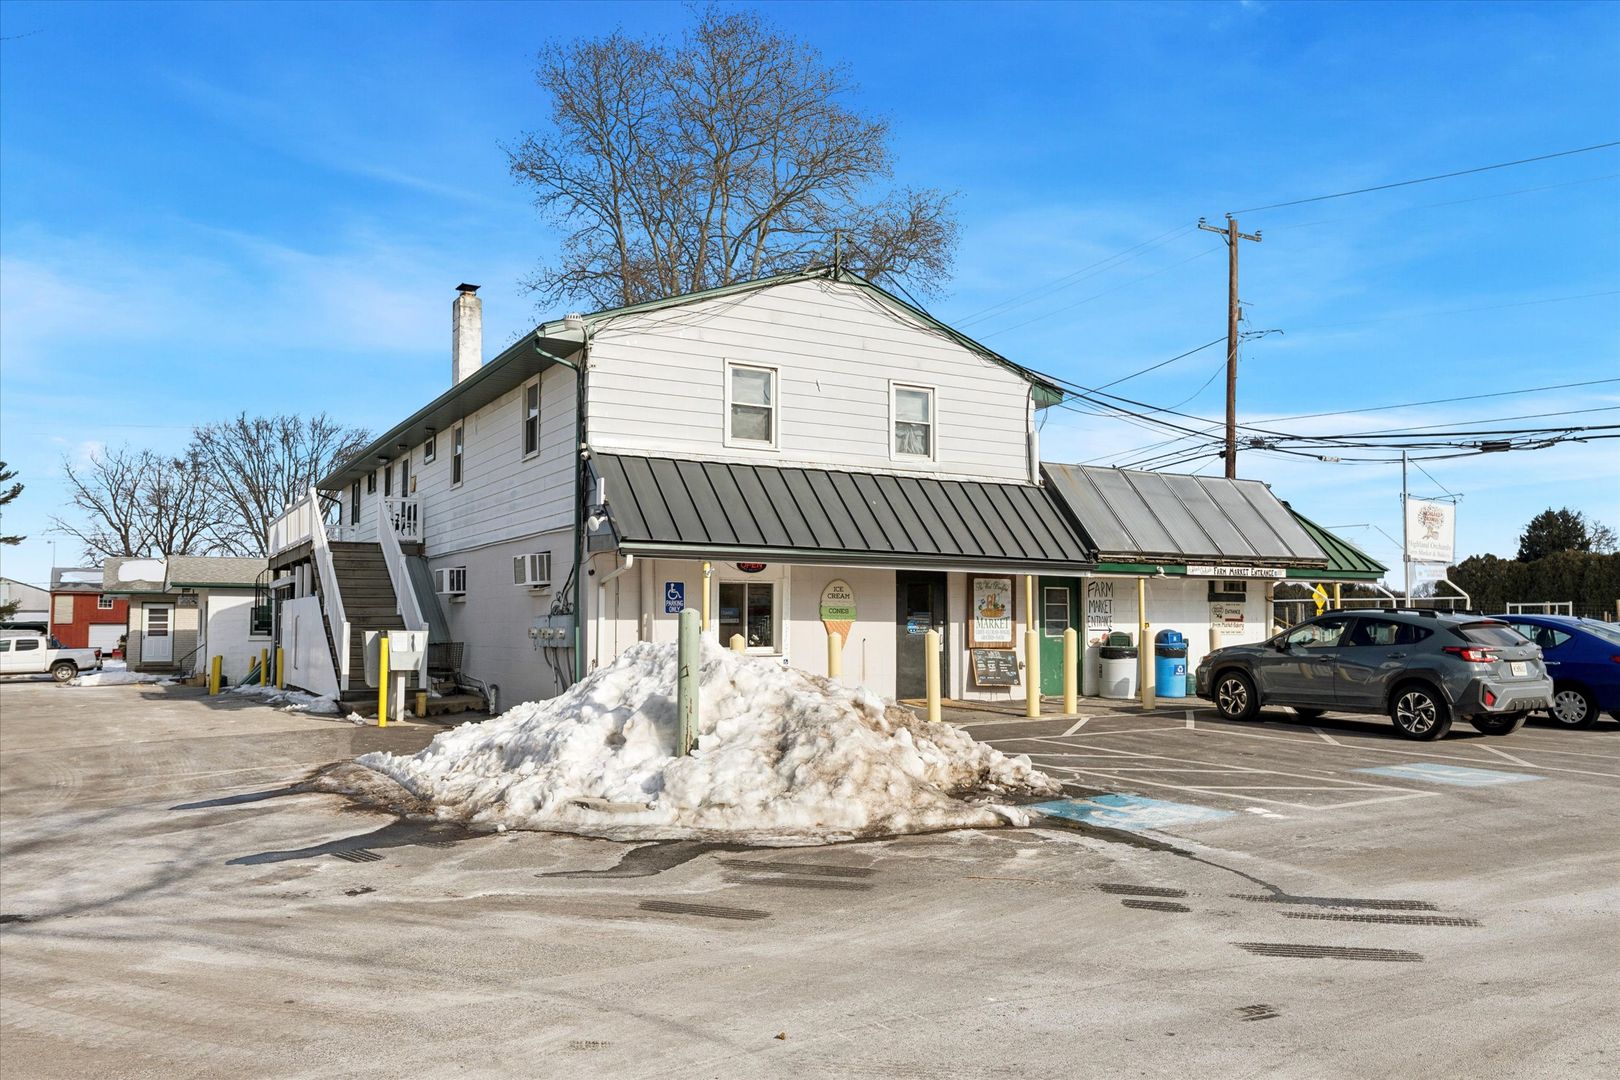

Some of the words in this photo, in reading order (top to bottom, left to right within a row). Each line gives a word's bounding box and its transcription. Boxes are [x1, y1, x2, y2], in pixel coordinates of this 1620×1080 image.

[1213, 566, 1227, 575] FARM
[1229, 567, 1249, 576] MARKET
[1088, 581, 1114, 598] FARM
[1088, 600, 1113, 614] MARKET
[976, 616, 1010, 629] MARKET
[1088, 615, 1113, 628] ENTRANCE
